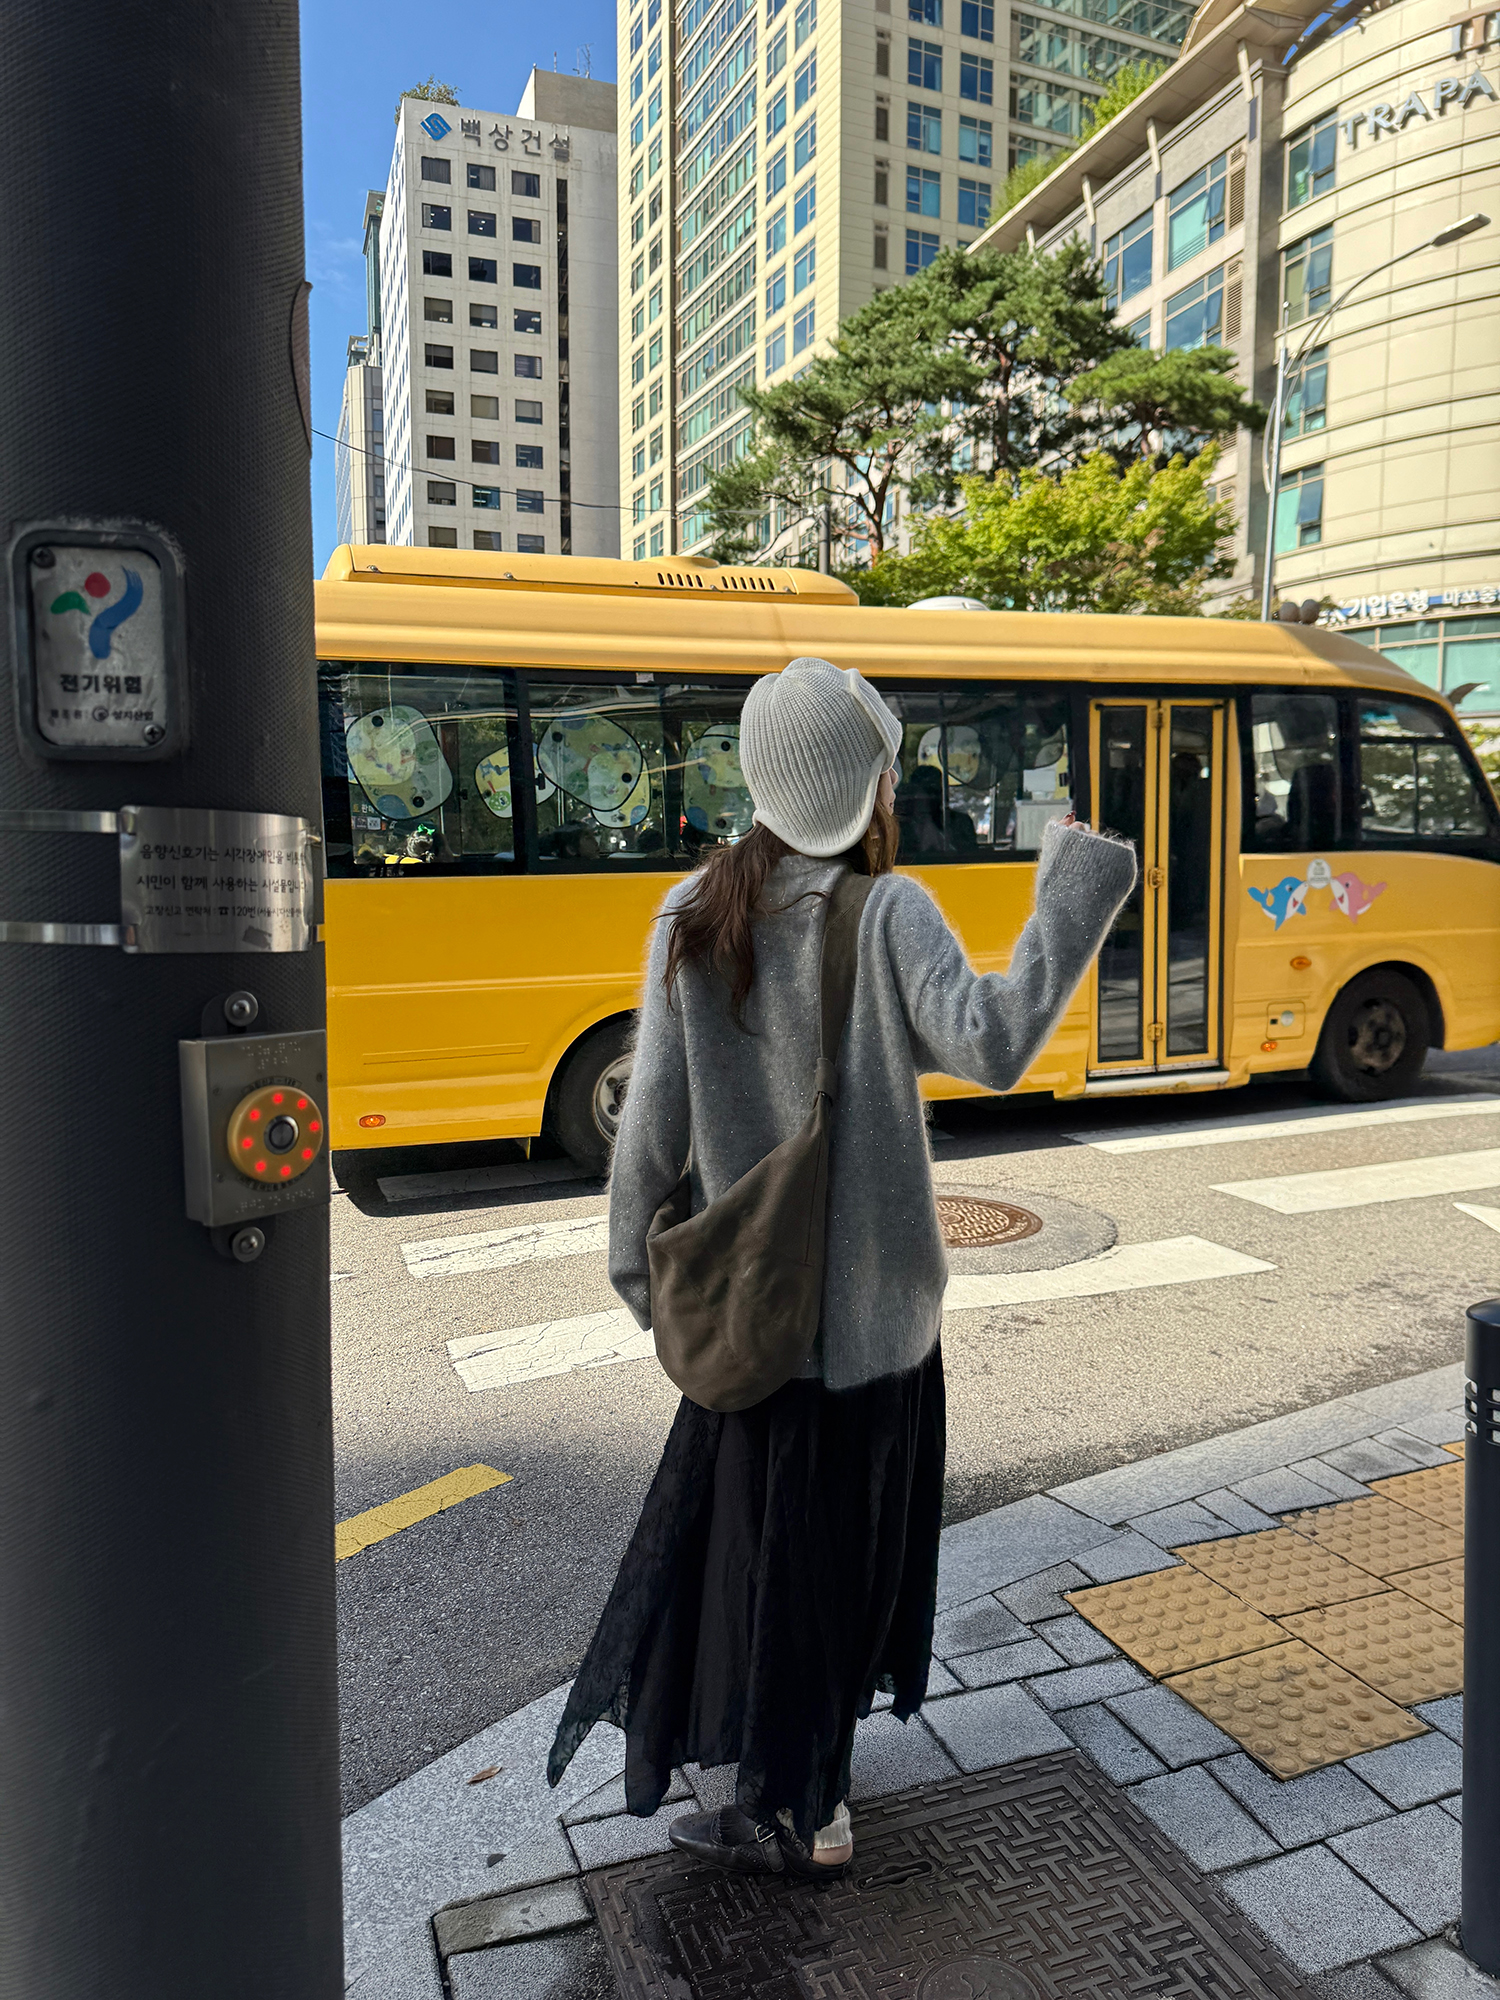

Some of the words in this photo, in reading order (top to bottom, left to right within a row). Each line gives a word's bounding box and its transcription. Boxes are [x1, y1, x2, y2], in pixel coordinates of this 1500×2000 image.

[1338, 68, 1497, 149] TRAPA
[460, 118, 571, 163] 백상건설
[1347, 588, 1430, 618] 기업은행
[1442, 586, 1500, 606] 마포중
[60, 674, 142, 694] 전기위험
[140, 844, 220, 860] 음향신호기는
[224, 847, 284, 865] 시각장애인을
[136, 875, 176, 890] 시민이
[181, 875, 208, 891] 함께
[212, 876, 258, 893] 사용하는
[145, 905, 182, 917] 고장신고
[231, 905, 256, 918] 120번
